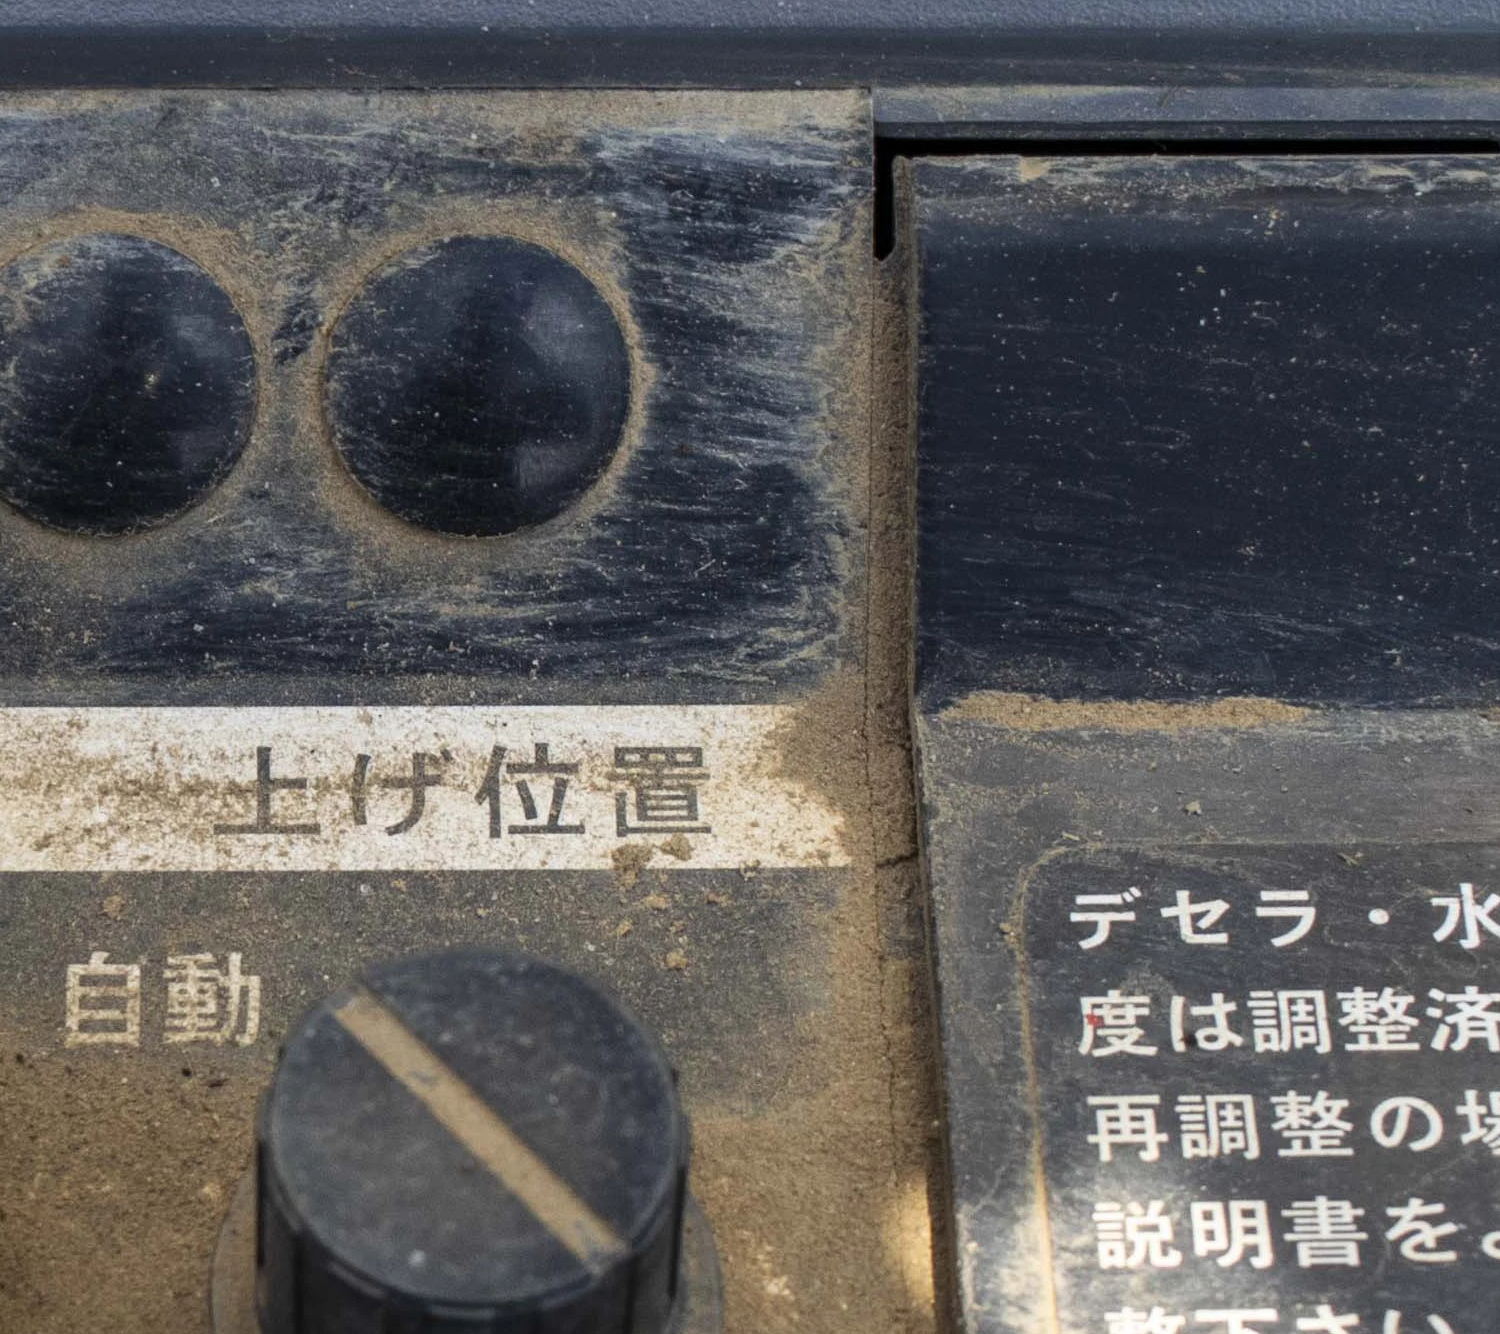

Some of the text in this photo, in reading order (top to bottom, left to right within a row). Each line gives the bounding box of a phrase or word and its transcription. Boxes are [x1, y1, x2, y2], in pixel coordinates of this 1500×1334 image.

[212, 742, 713, 838] 上げ位置
[65, 950, 262, 1048] 自動
